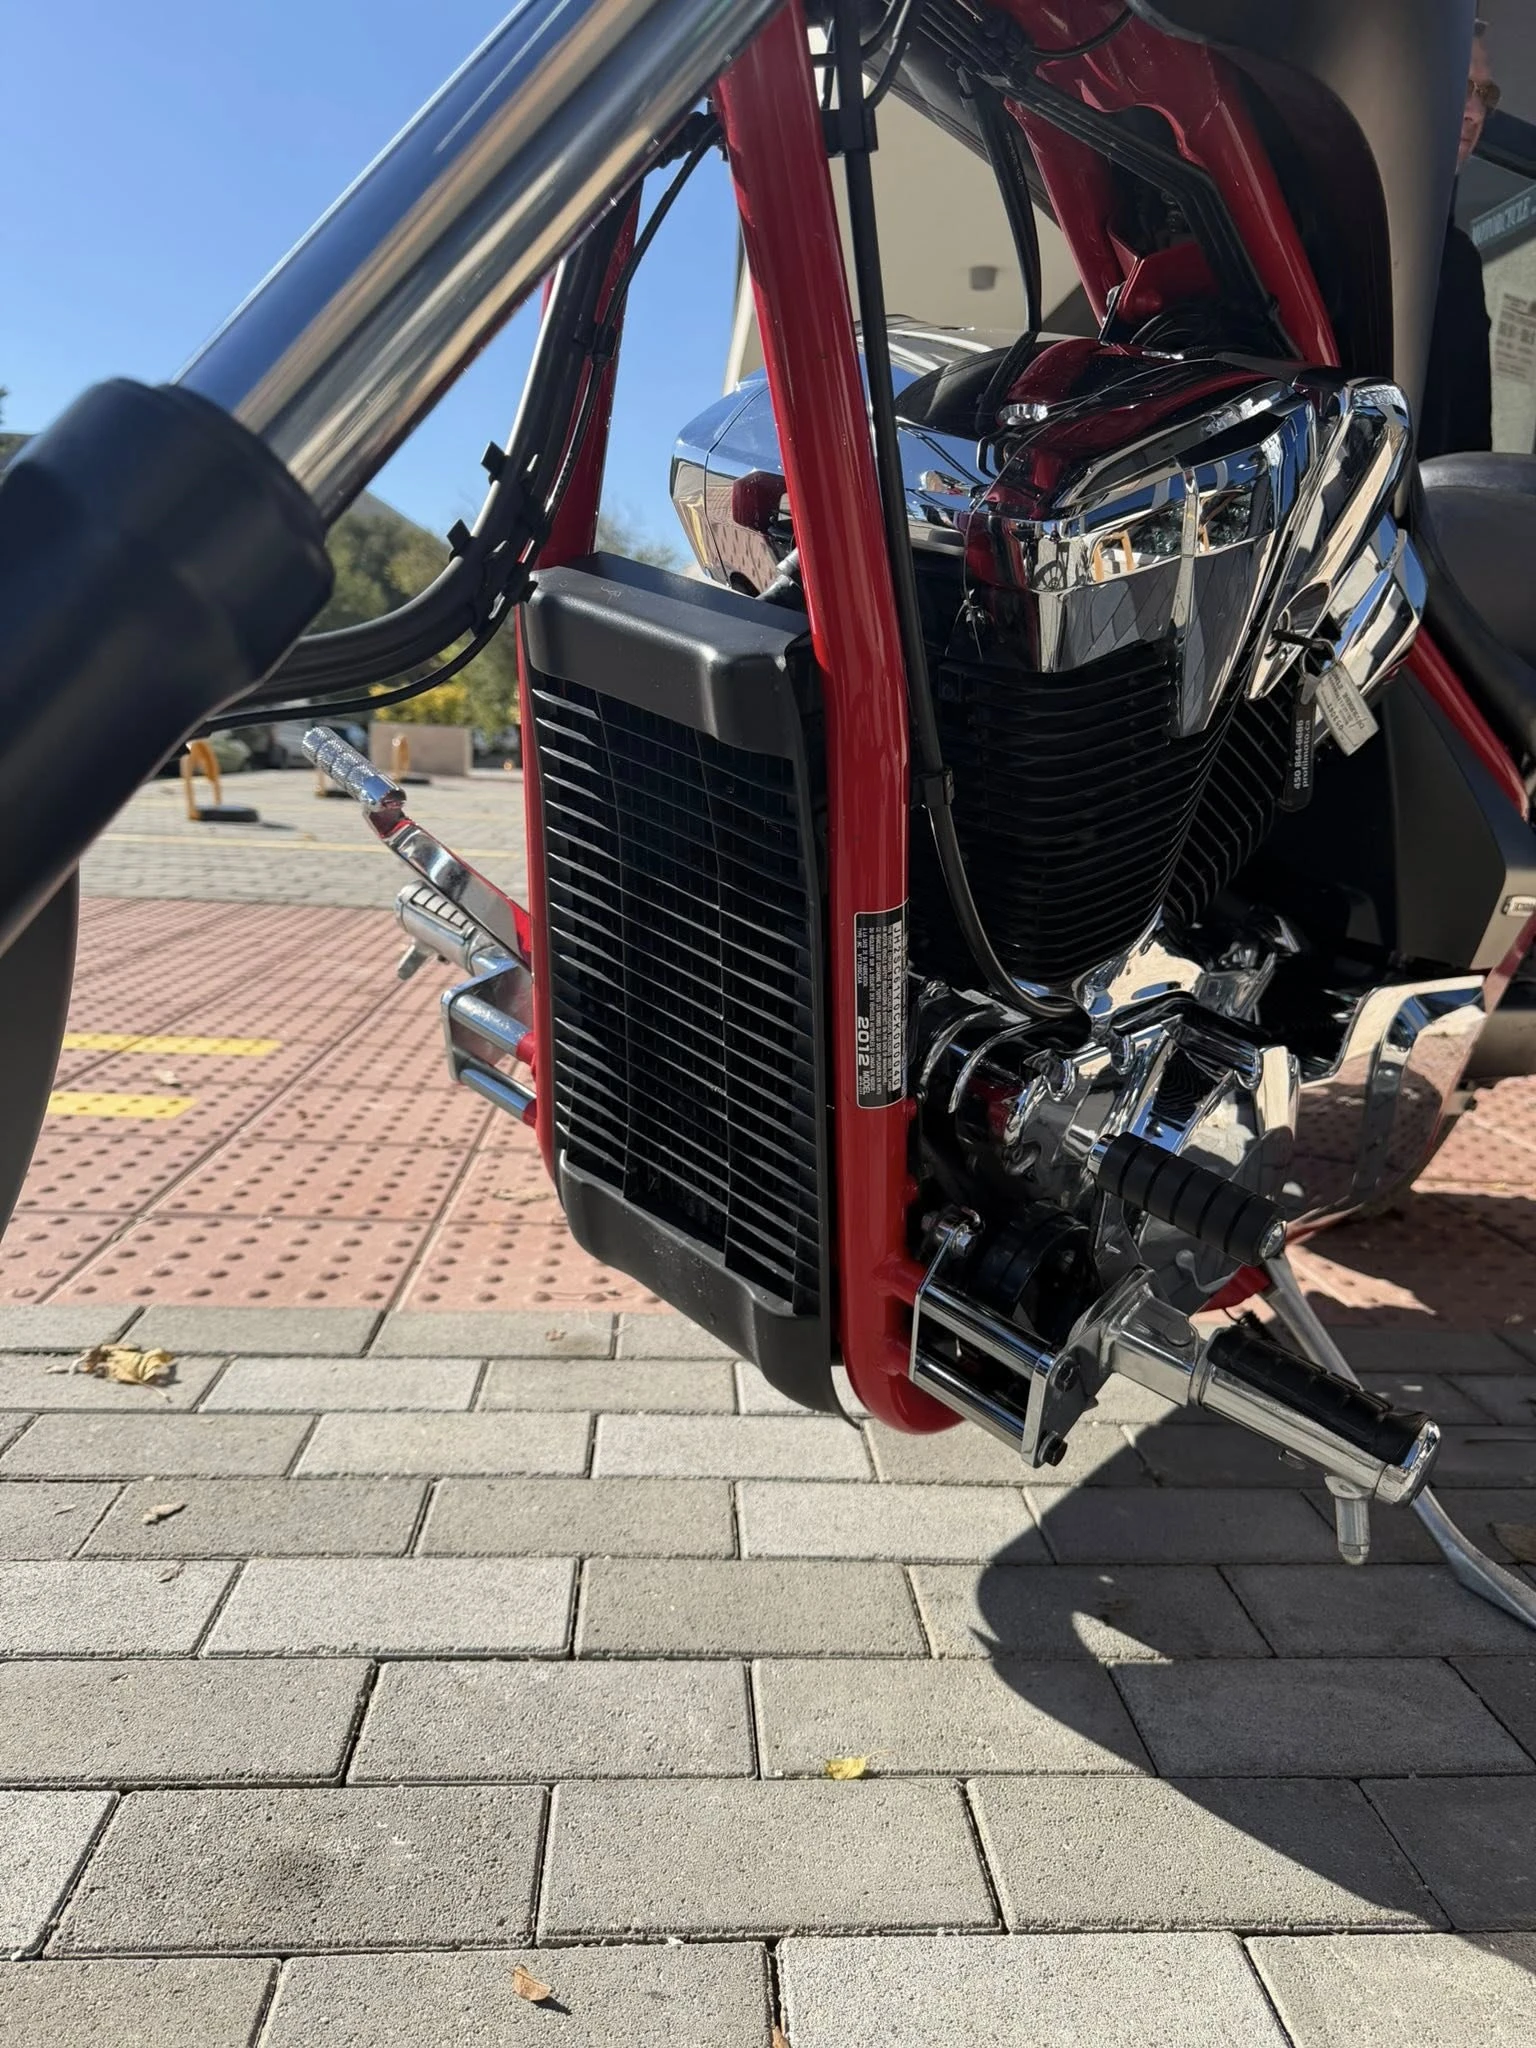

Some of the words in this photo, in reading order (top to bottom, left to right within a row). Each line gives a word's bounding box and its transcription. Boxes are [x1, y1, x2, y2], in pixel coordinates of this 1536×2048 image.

[1302, 720, 1311, 788] profilmoto.ca
[1294, 771, 1302, 790] 450
[858, 1016, 869, 1066] 2012
